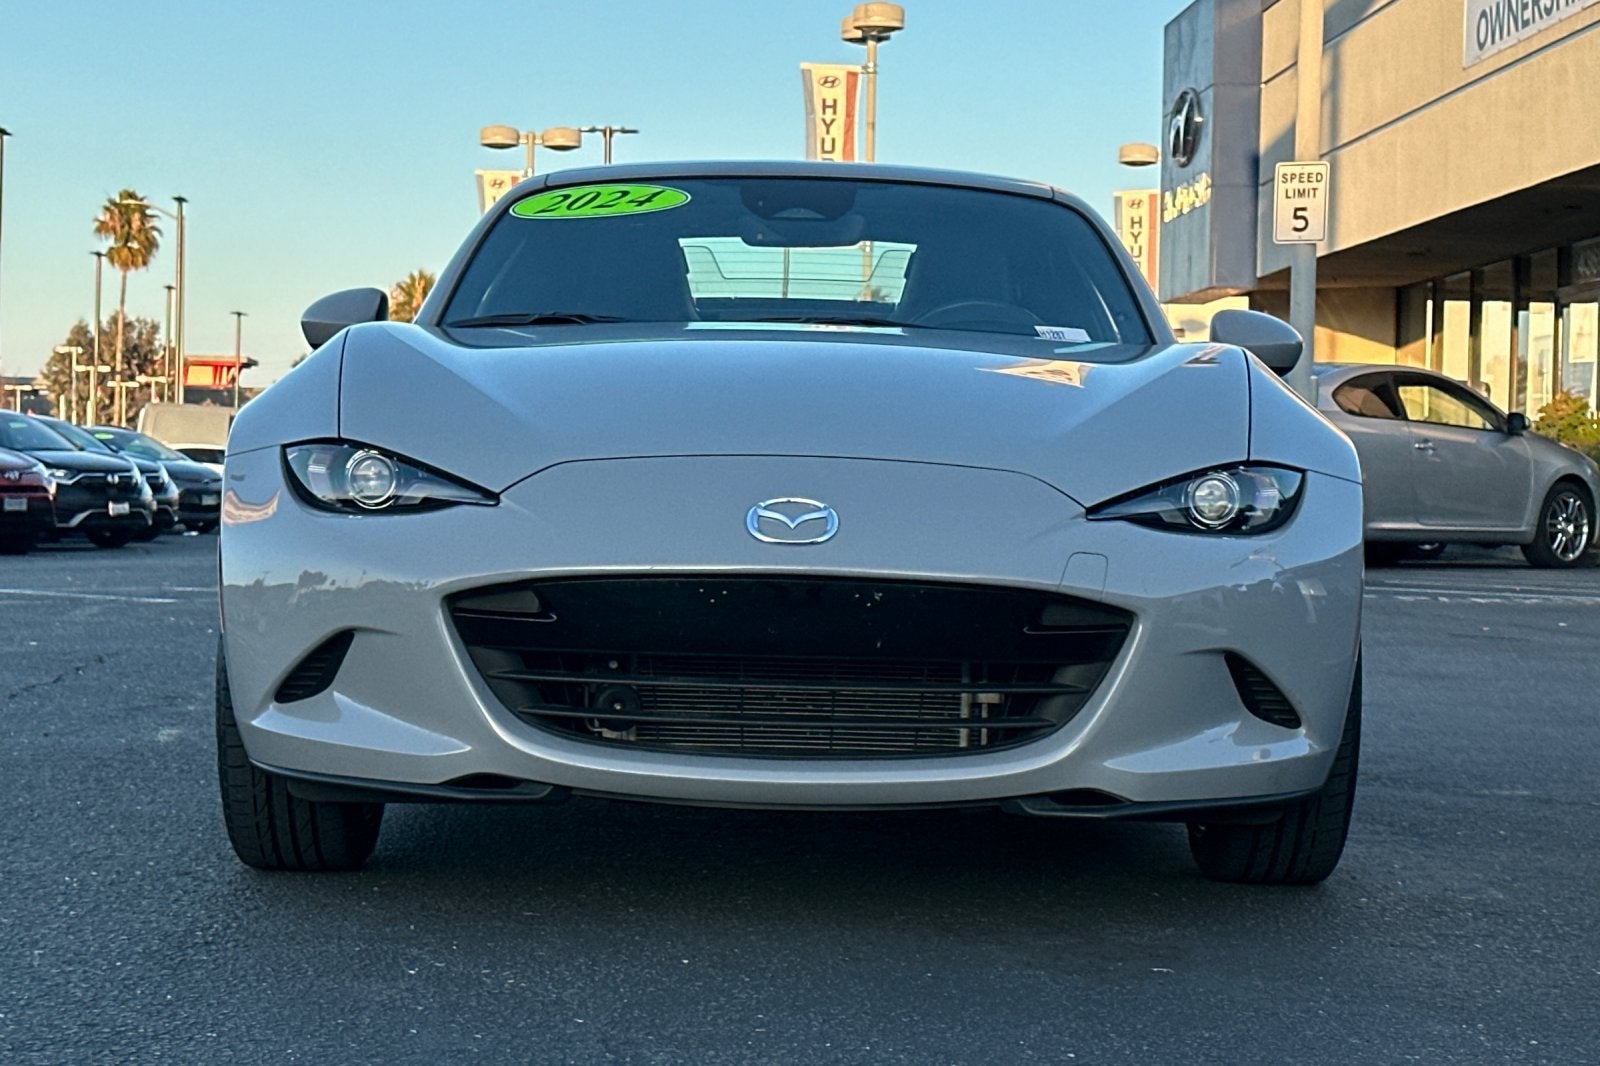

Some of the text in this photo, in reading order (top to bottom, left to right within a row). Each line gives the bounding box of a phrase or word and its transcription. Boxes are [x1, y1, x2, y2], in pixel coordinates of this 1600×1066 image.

[821, 98, 837, 162] HYU
[1281, 172, 1324, 184] SPEED
[533, 188, 667, 214] 2024
[1285, 187, 1319, 199] LIMIT
[1292, 206, 1309, 233] 5
